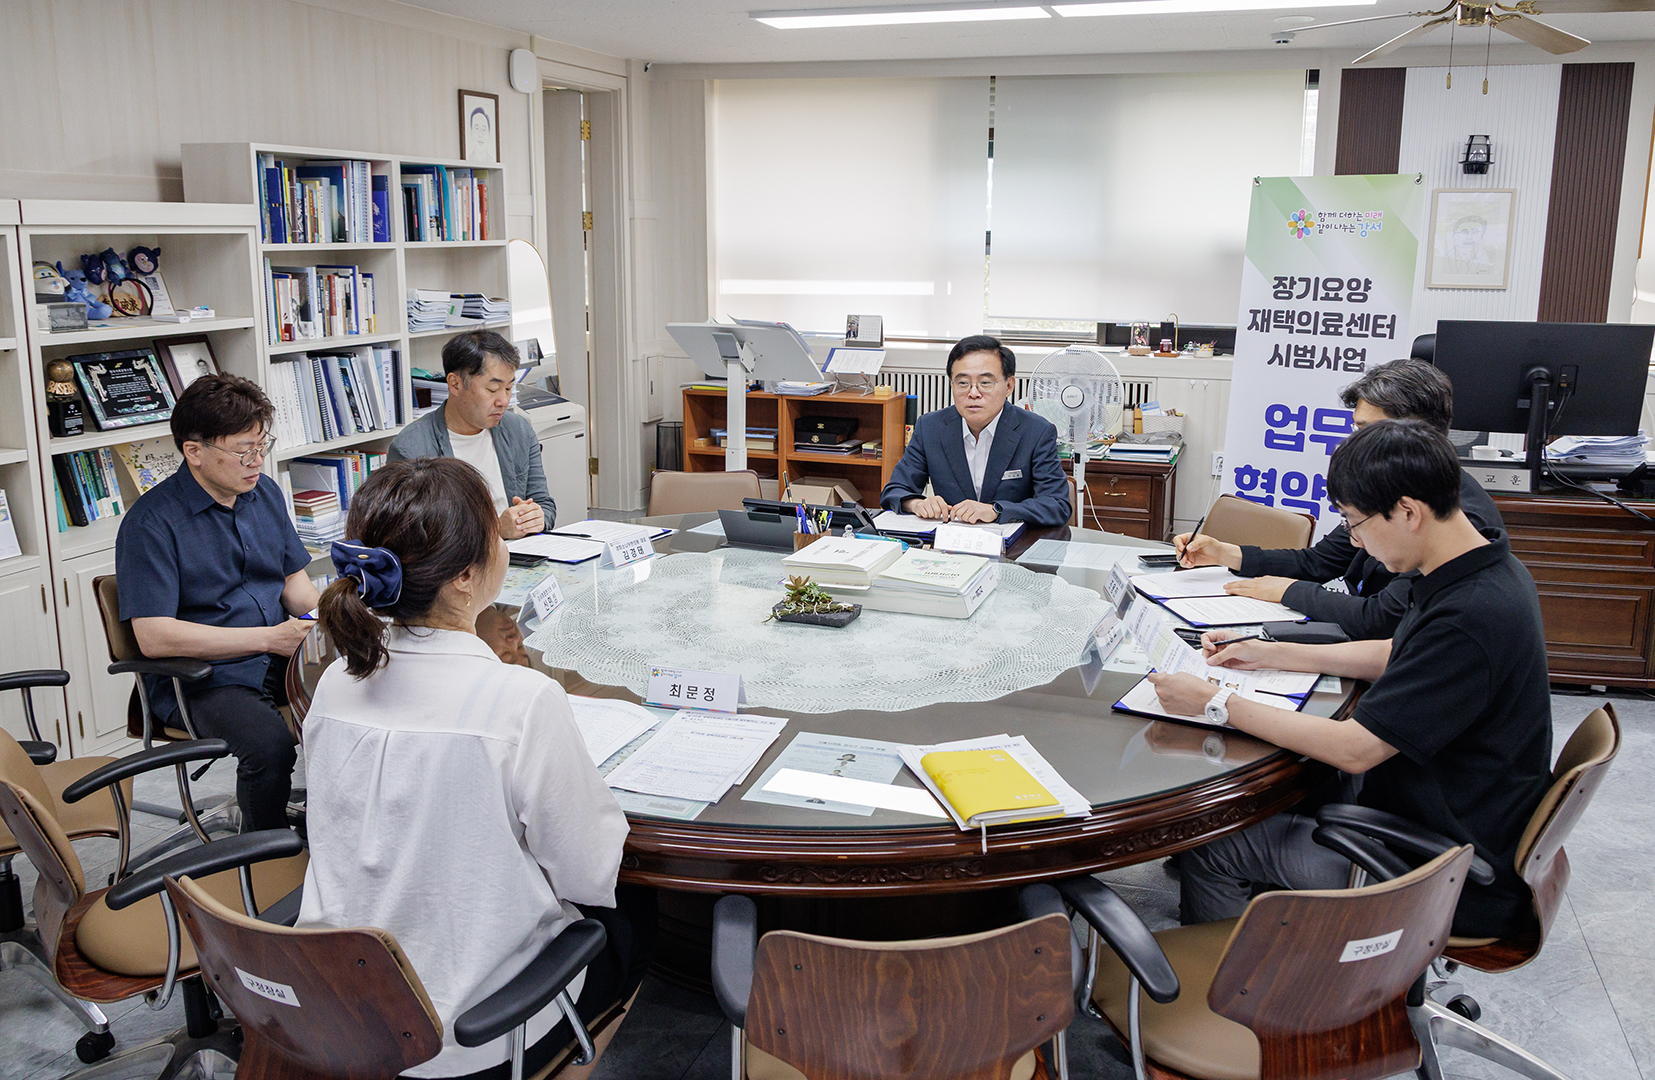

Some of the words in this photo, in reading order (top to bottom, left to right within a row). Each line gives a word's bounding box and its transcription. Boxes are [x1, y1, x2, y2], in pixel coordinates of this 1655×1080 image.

[1316, 223, 1333, 234] 같이
[1334, 223, 1356, 233] 나누는
[1357, 222, 1382, 238] 강서
[1318, 211, 1337, 222] 함께
[1339, 211, 1363, 221] 더하는
[1364, 211, 1383, 219] 미래
[1272, 275, 1373, 304] 장기요양
[1246, 308, 1397, 340] 재택의료센터
[1266, 343, 1367, 373] 시범사업
[1264, 403, 1355, 456] 업무
[668, 683, 716, 702] 최문정
